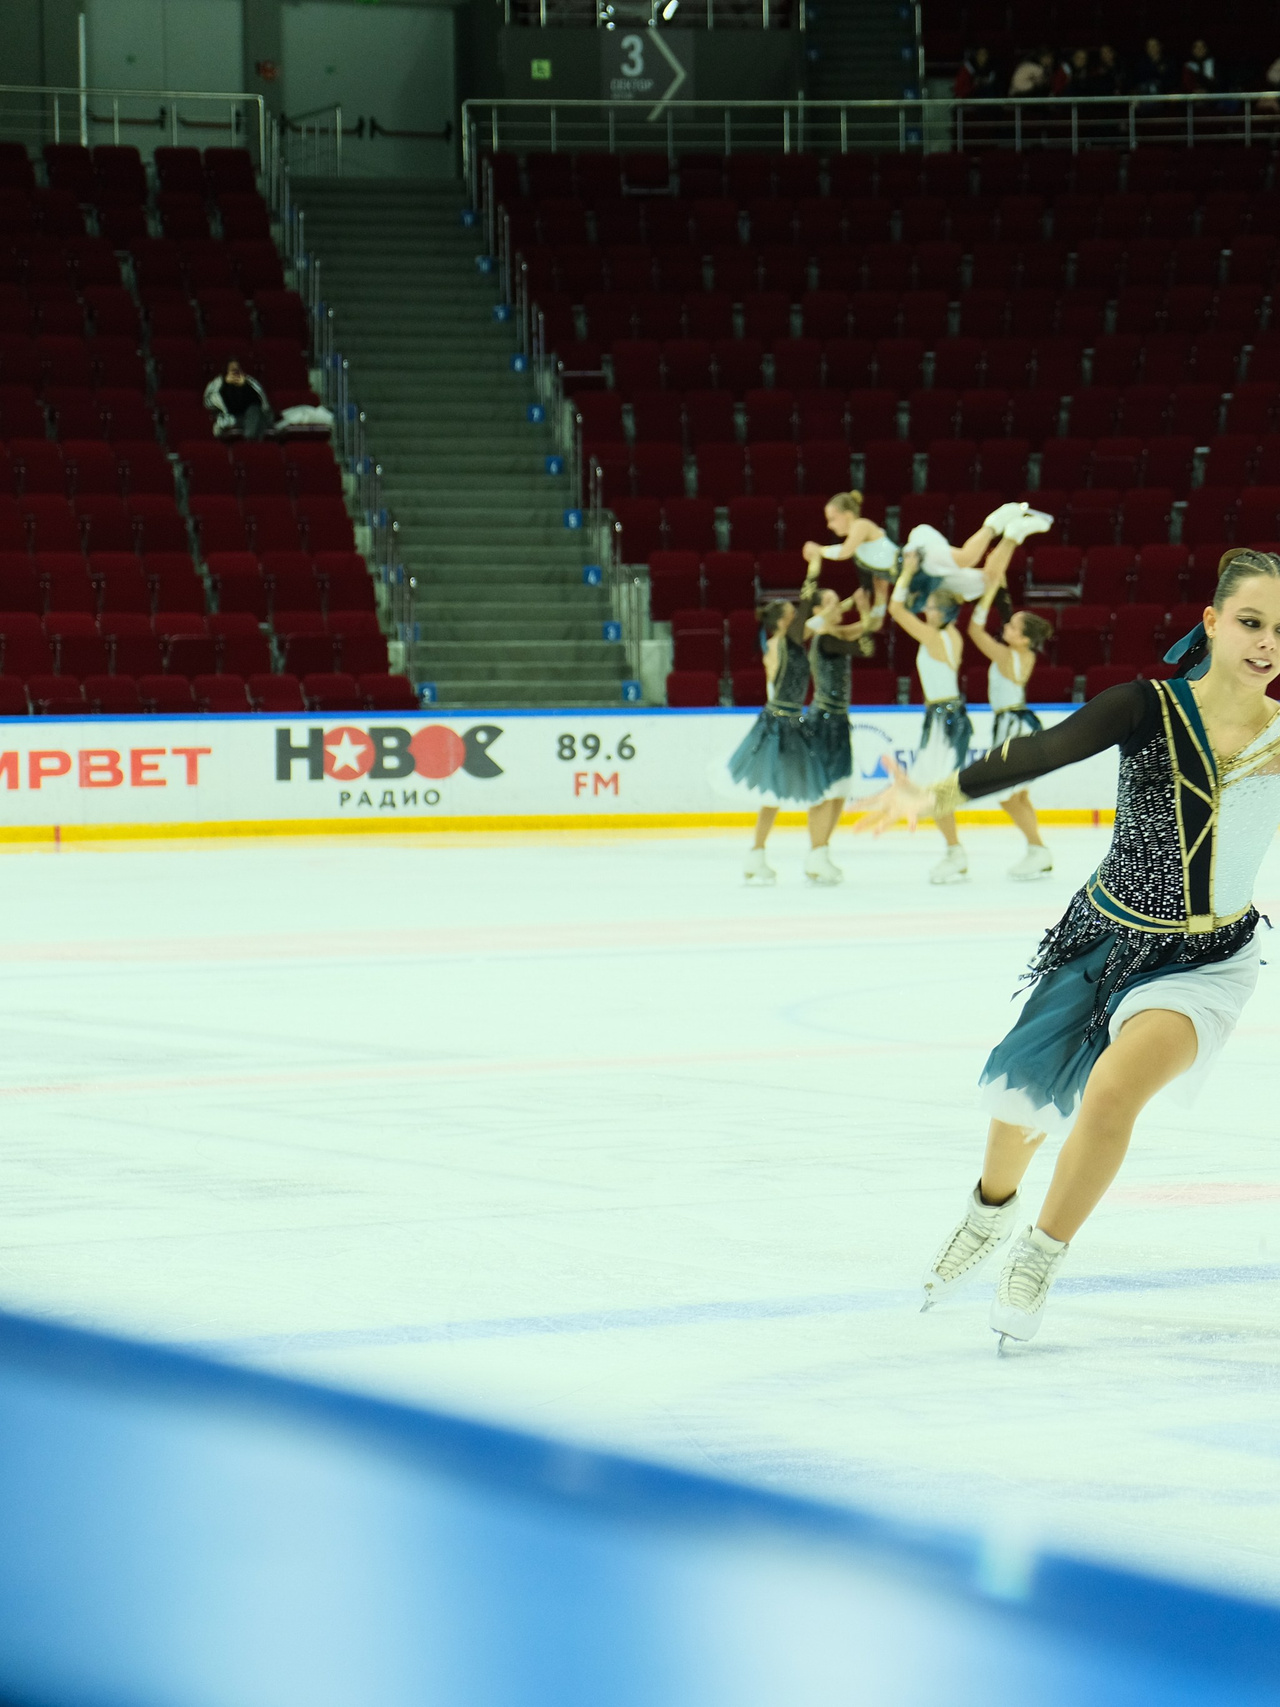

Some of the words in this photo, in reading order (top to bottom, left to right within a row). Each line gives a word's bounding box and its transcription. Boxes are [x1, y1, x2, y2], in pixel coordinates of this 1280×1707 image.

[620, 34, 644, 77] 3
[557, 733, 636, 760] 89.6
[574, 771, 619, 796] FM
[339, 789, 441, 809] РАДИО
